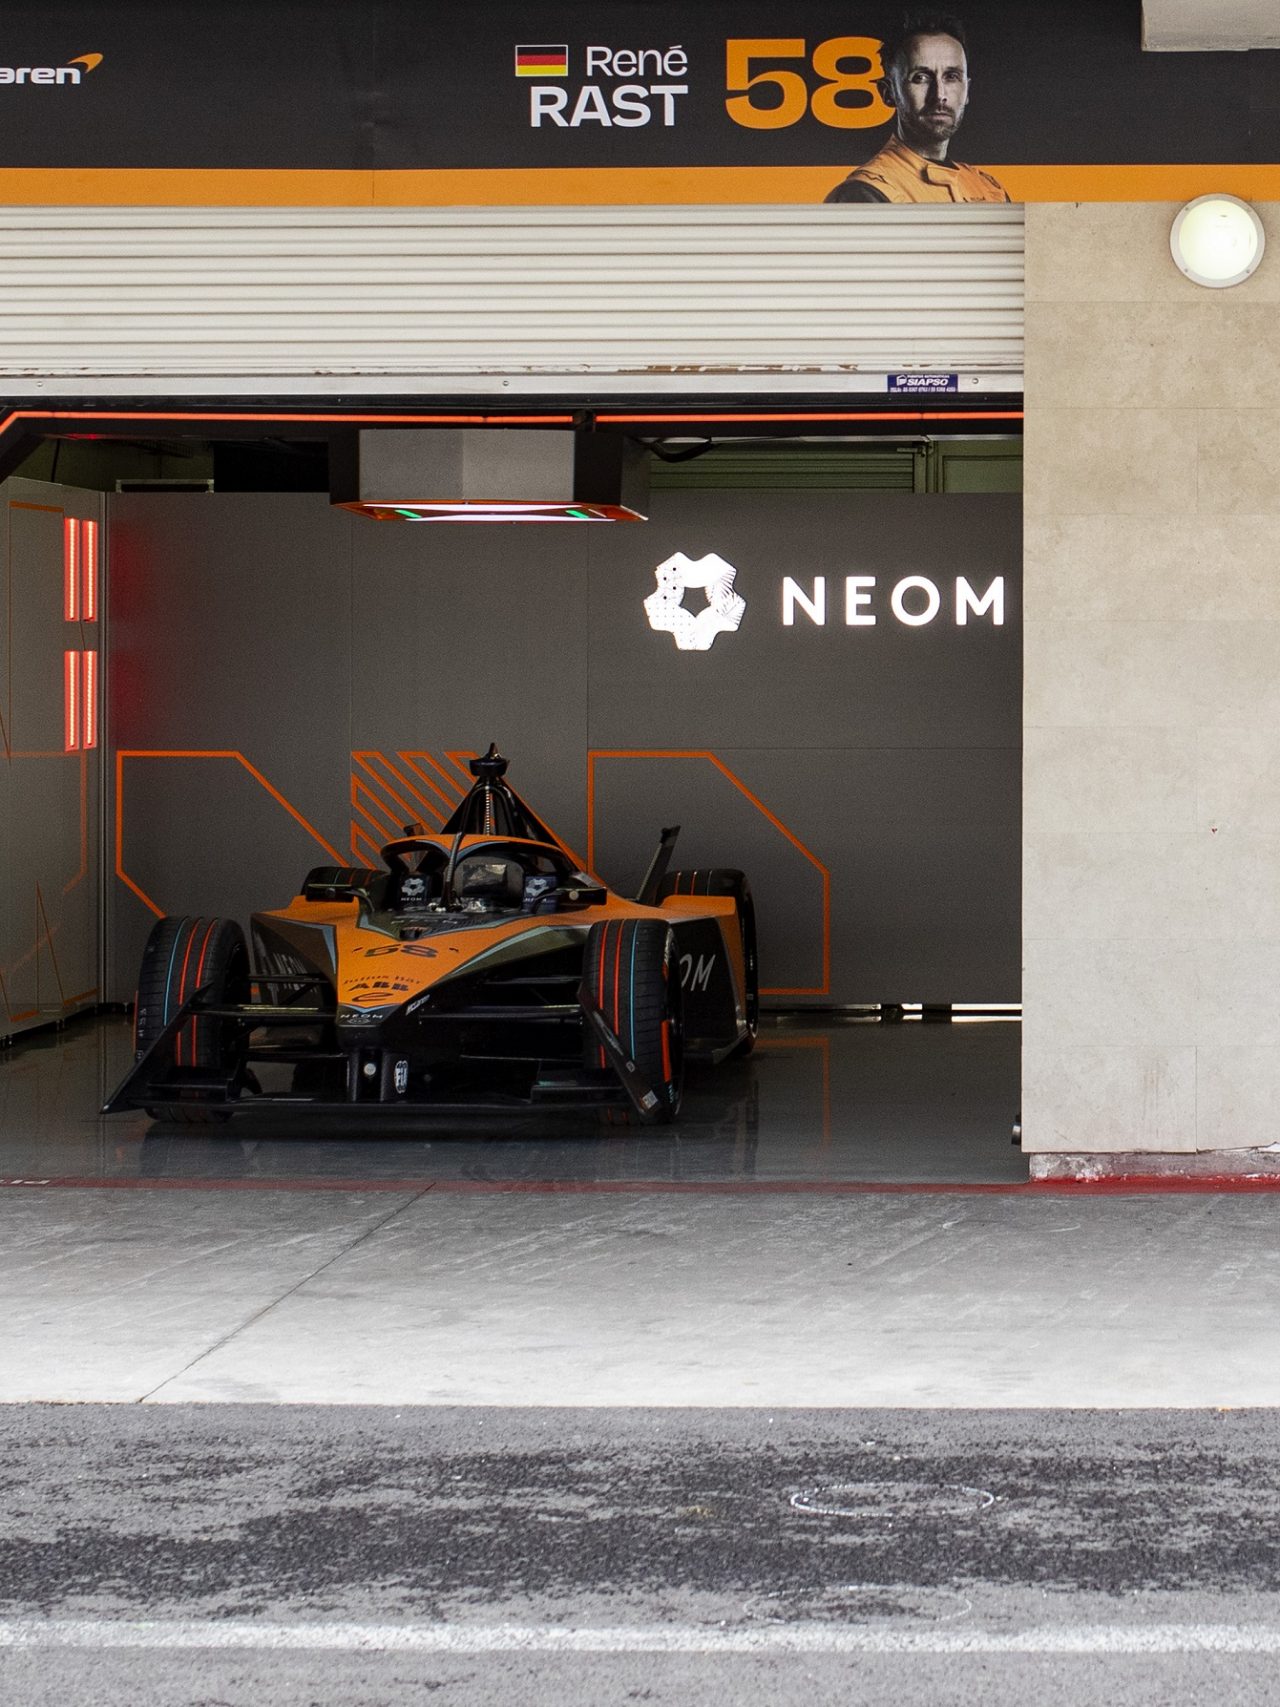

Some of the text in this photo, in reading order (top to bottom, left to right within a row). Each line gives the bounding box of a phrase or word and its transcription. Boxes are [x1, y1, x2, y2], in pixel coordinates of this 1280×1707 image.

[587, 44, 688, 77] René
[725, 36, 897, 130] 58
[530, 85, 689, 128] RAST
[907, 378, 949, 386] SIAPSO
[782, 576, 1005, 626] NEOM
